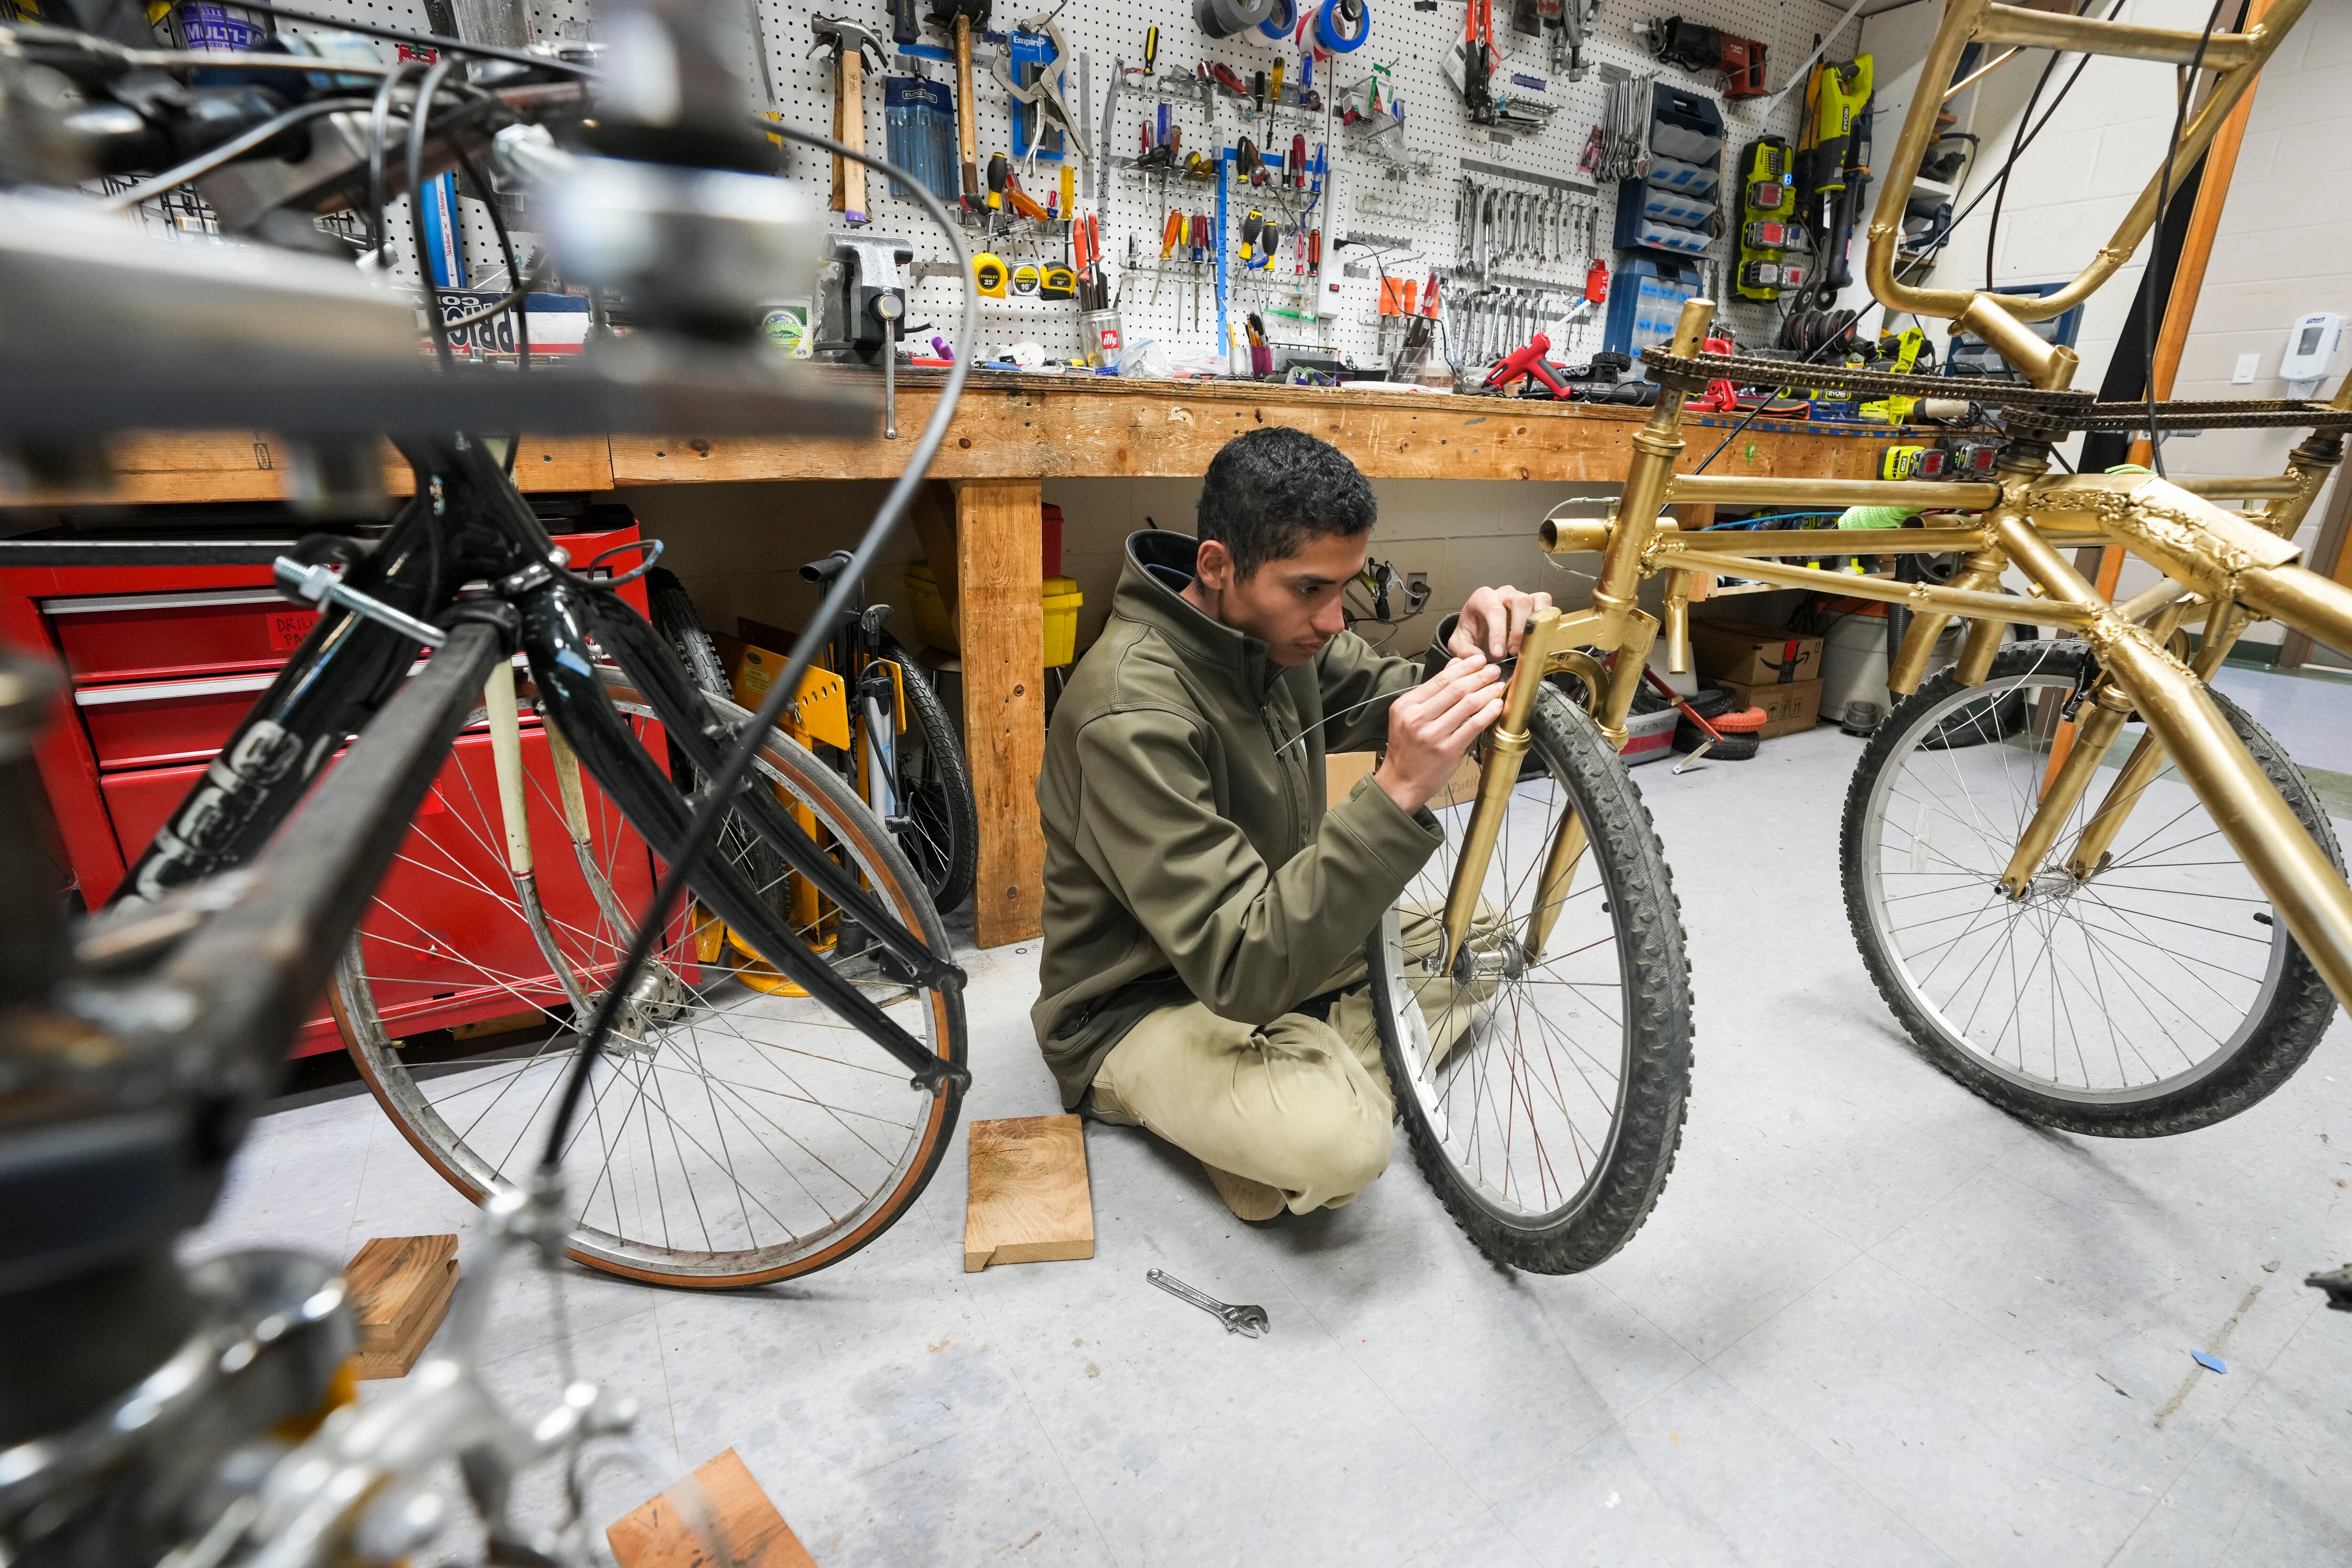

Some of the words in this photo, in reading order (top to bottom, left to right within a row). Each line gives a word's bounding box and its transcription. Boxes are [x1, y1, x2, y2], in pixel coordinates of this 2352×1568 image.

[1013, 35, 1041, 47] Empire
[402, 56, 430, 67] Nicholson
[1099, 172, 1108, 198] Drivers
[444, 233, 453, 257] Nicholson
[766, 324, 798, 333] organic
[1103, 333, 1117, 347] illy
[285, 633, 307, 645] PA
